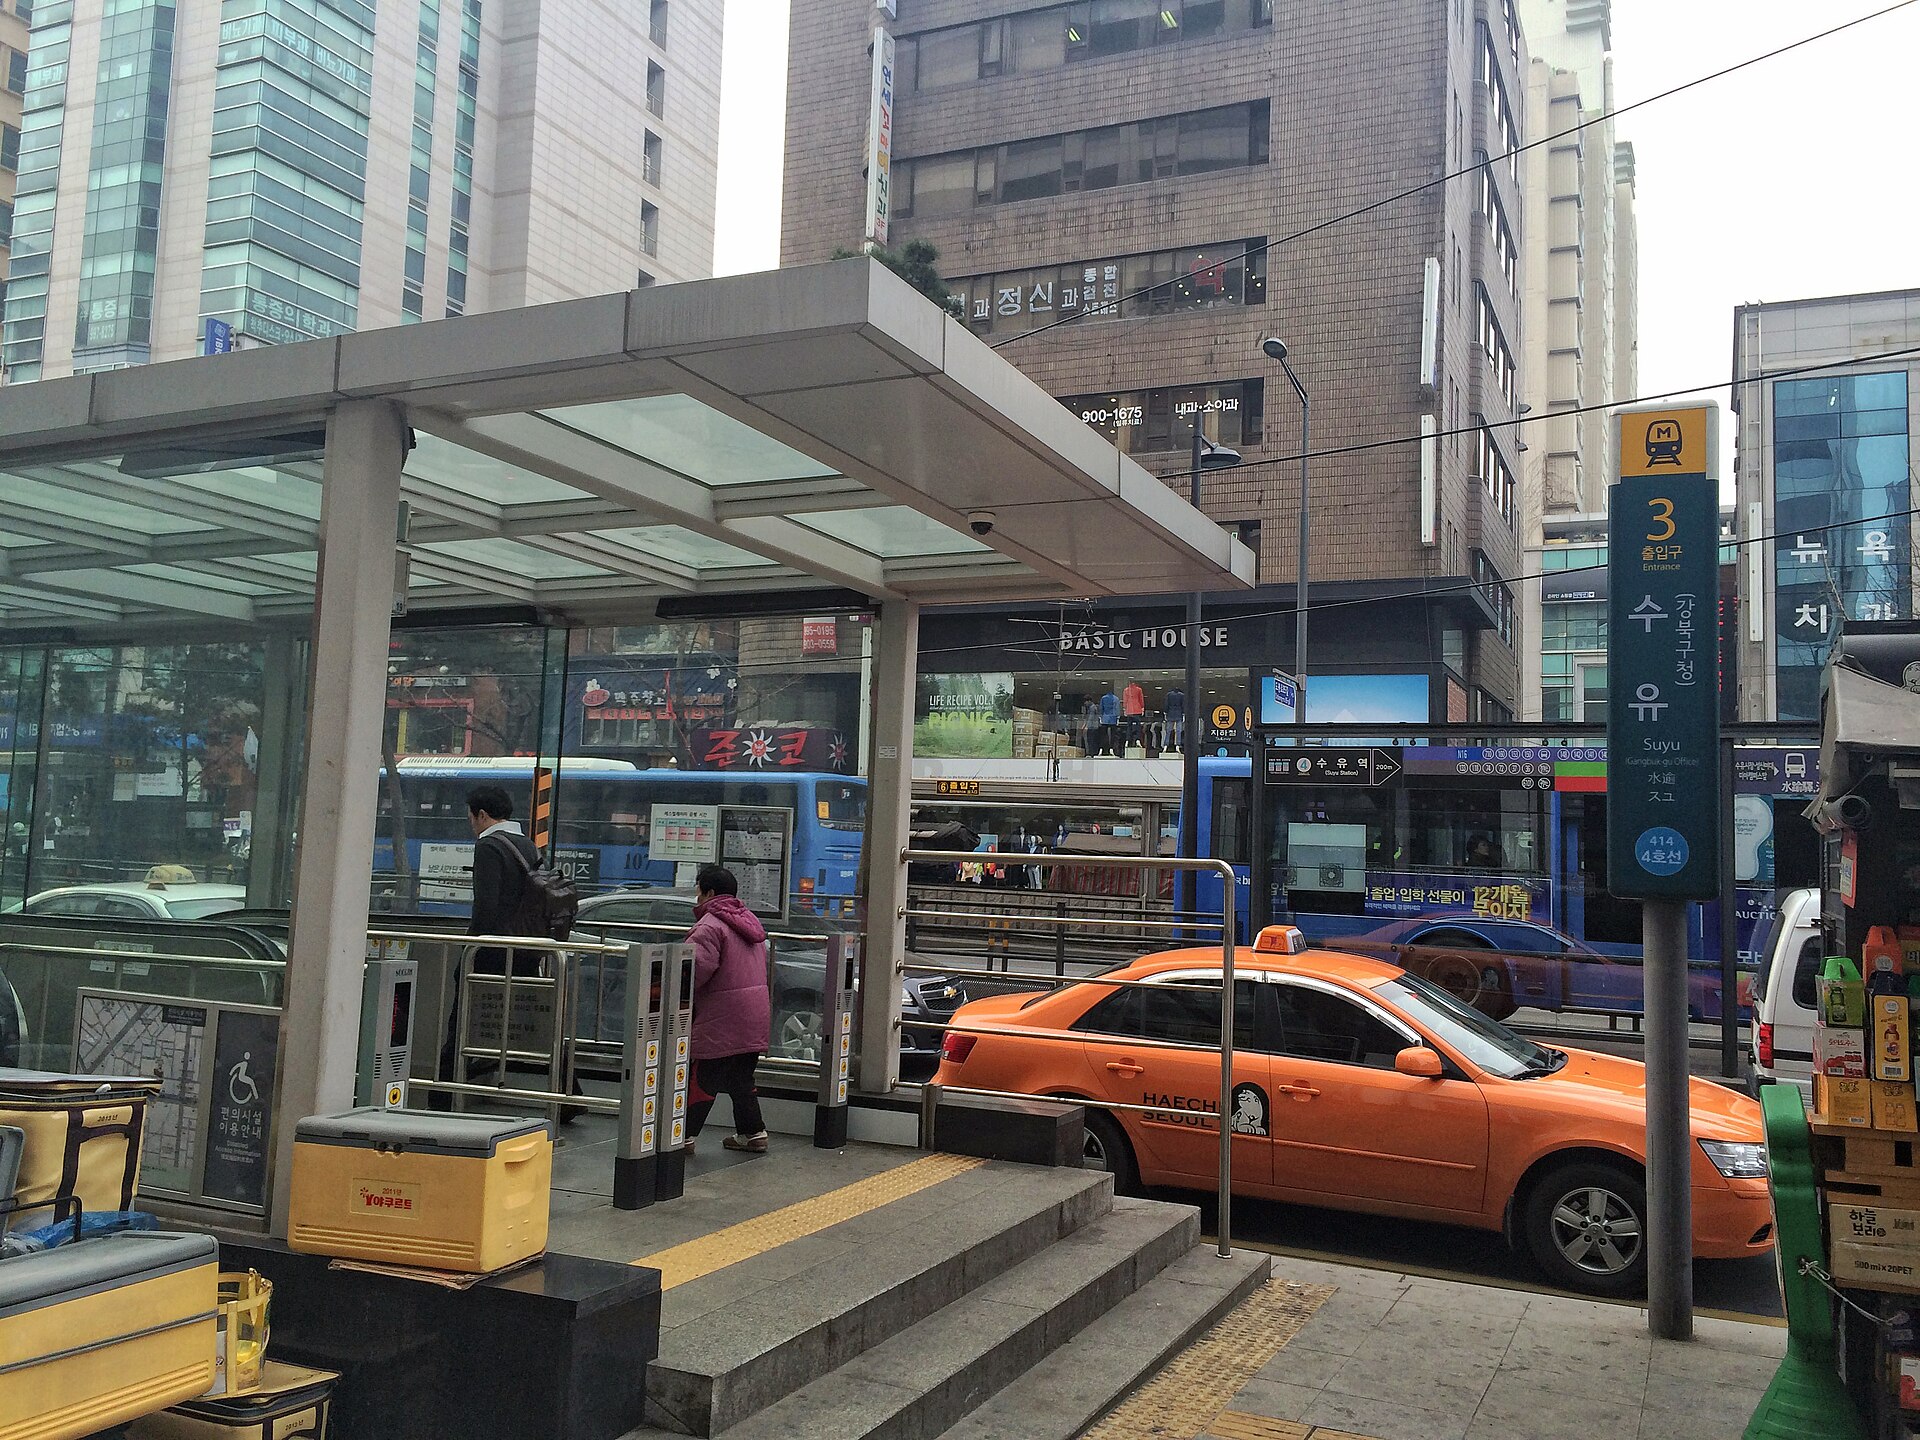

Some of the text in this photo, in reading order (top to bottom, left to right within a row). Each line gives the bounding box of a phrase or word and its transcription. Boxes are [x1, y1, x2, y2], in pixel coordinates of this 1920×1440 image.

[271, 19, 357, 82] 피부과 비뇨기과
[1084, 264, 1118, 283] 종합
[1083, 282, 1117, 301] 검진
[252, 291, 331, 337] 통증의학과
[1082, 406, 1142, 424] 900-1675
[1175, 398, 1239, 415] 내과·소아과
[1646, 498, 1676, 541] 3
[1642, 545, 1682, 561] 출입구
[1643, 563, 1681, 571] Entrance
[1060, 631, 1132, 650] BASIC
[1674, 593, 1696, 686] (강북구청)
[1628, 594, 1669, 722] 수유
[929, 694, 945, 706] LIFE
[946, 694, 973, 706] RECIPE
[1210, 729, 1237, 737] 지하철
[1457, 749, 1468, 759] N16
[1643, 738, 1681, 753] Suyu
[1299, 758, 1307, 769] 4
[1316, 757, 1368, 769] 수유역
[940, 781, 978, 793] 6 출입구
[1650, 836, 1673, 846] 414
[1642, 850, 1681, 864] 4호선
[1371, 886, 1425, 902] 졸업·입학
[1427, 888, 1465, 904] 선물이
[1472, 884, 1529, 905] 12개월
[1471, 900, 1529, 921] 무이자
[220, 1106, 262, 1124] 편의시설
[1143, 1111, 1213, 1128] SEOUL
[219, 1122, 262, 1140] 이용안내
[373, 1195, 413, 1210] 야쿠르트
[1849, 1208, 1877, 1226] 하늘
[1853, 1222, 1876, 1237] 보리
